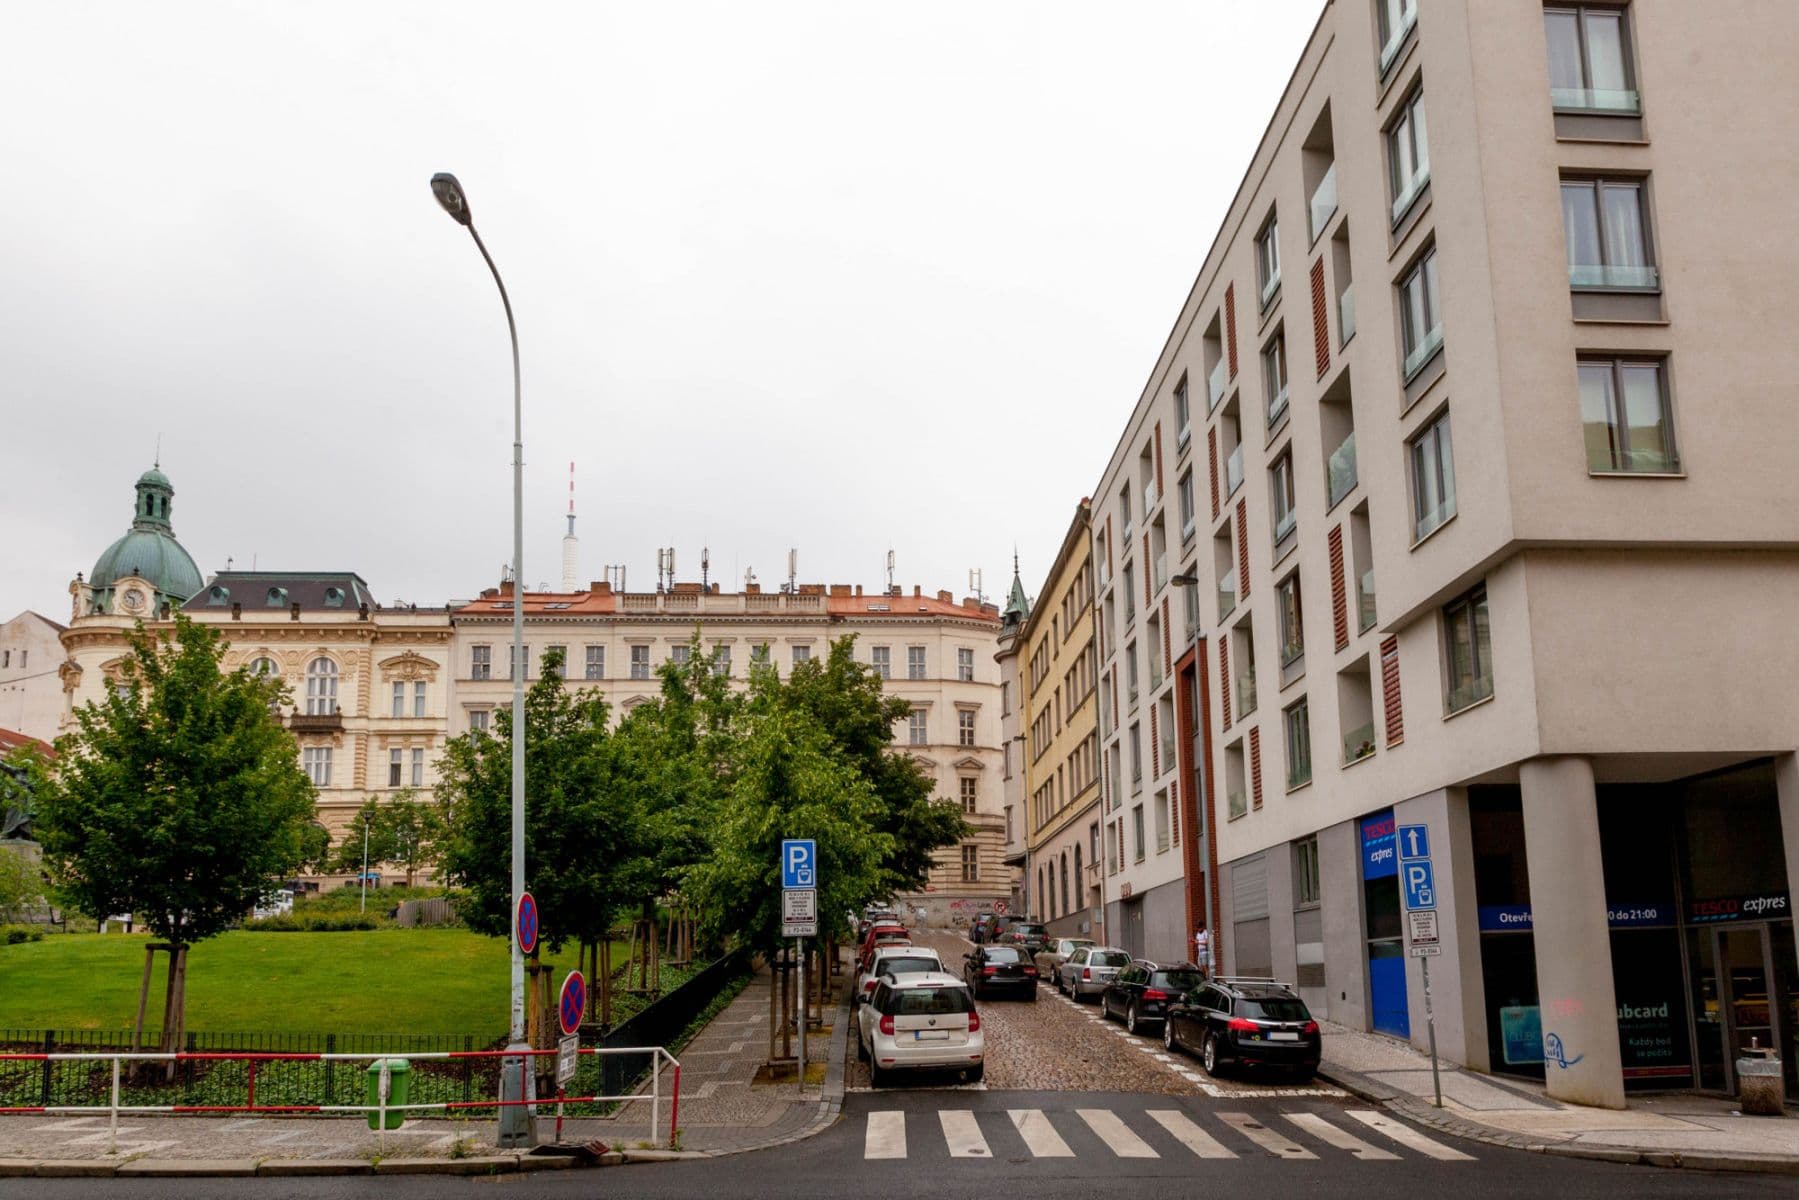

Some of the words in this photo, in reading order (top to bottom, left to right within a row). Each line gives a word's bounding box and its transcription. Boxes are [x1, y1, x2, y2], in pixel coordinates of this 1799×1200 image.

[789, 846, 808, 874] P
[1370, 847, 1393, 864] expres
[1409, 866, 1427, 894] P
[1691, 899, 1738, 915] TESCO
[1743, 896, 1786, 914] expres
[1499, 911, 1533, 923] Otevře
[1616, 910, 1629, 920] do
[1629, 909, 1657, 920] 21:00
[1616, 1002, 1668, 1018] ubcard
